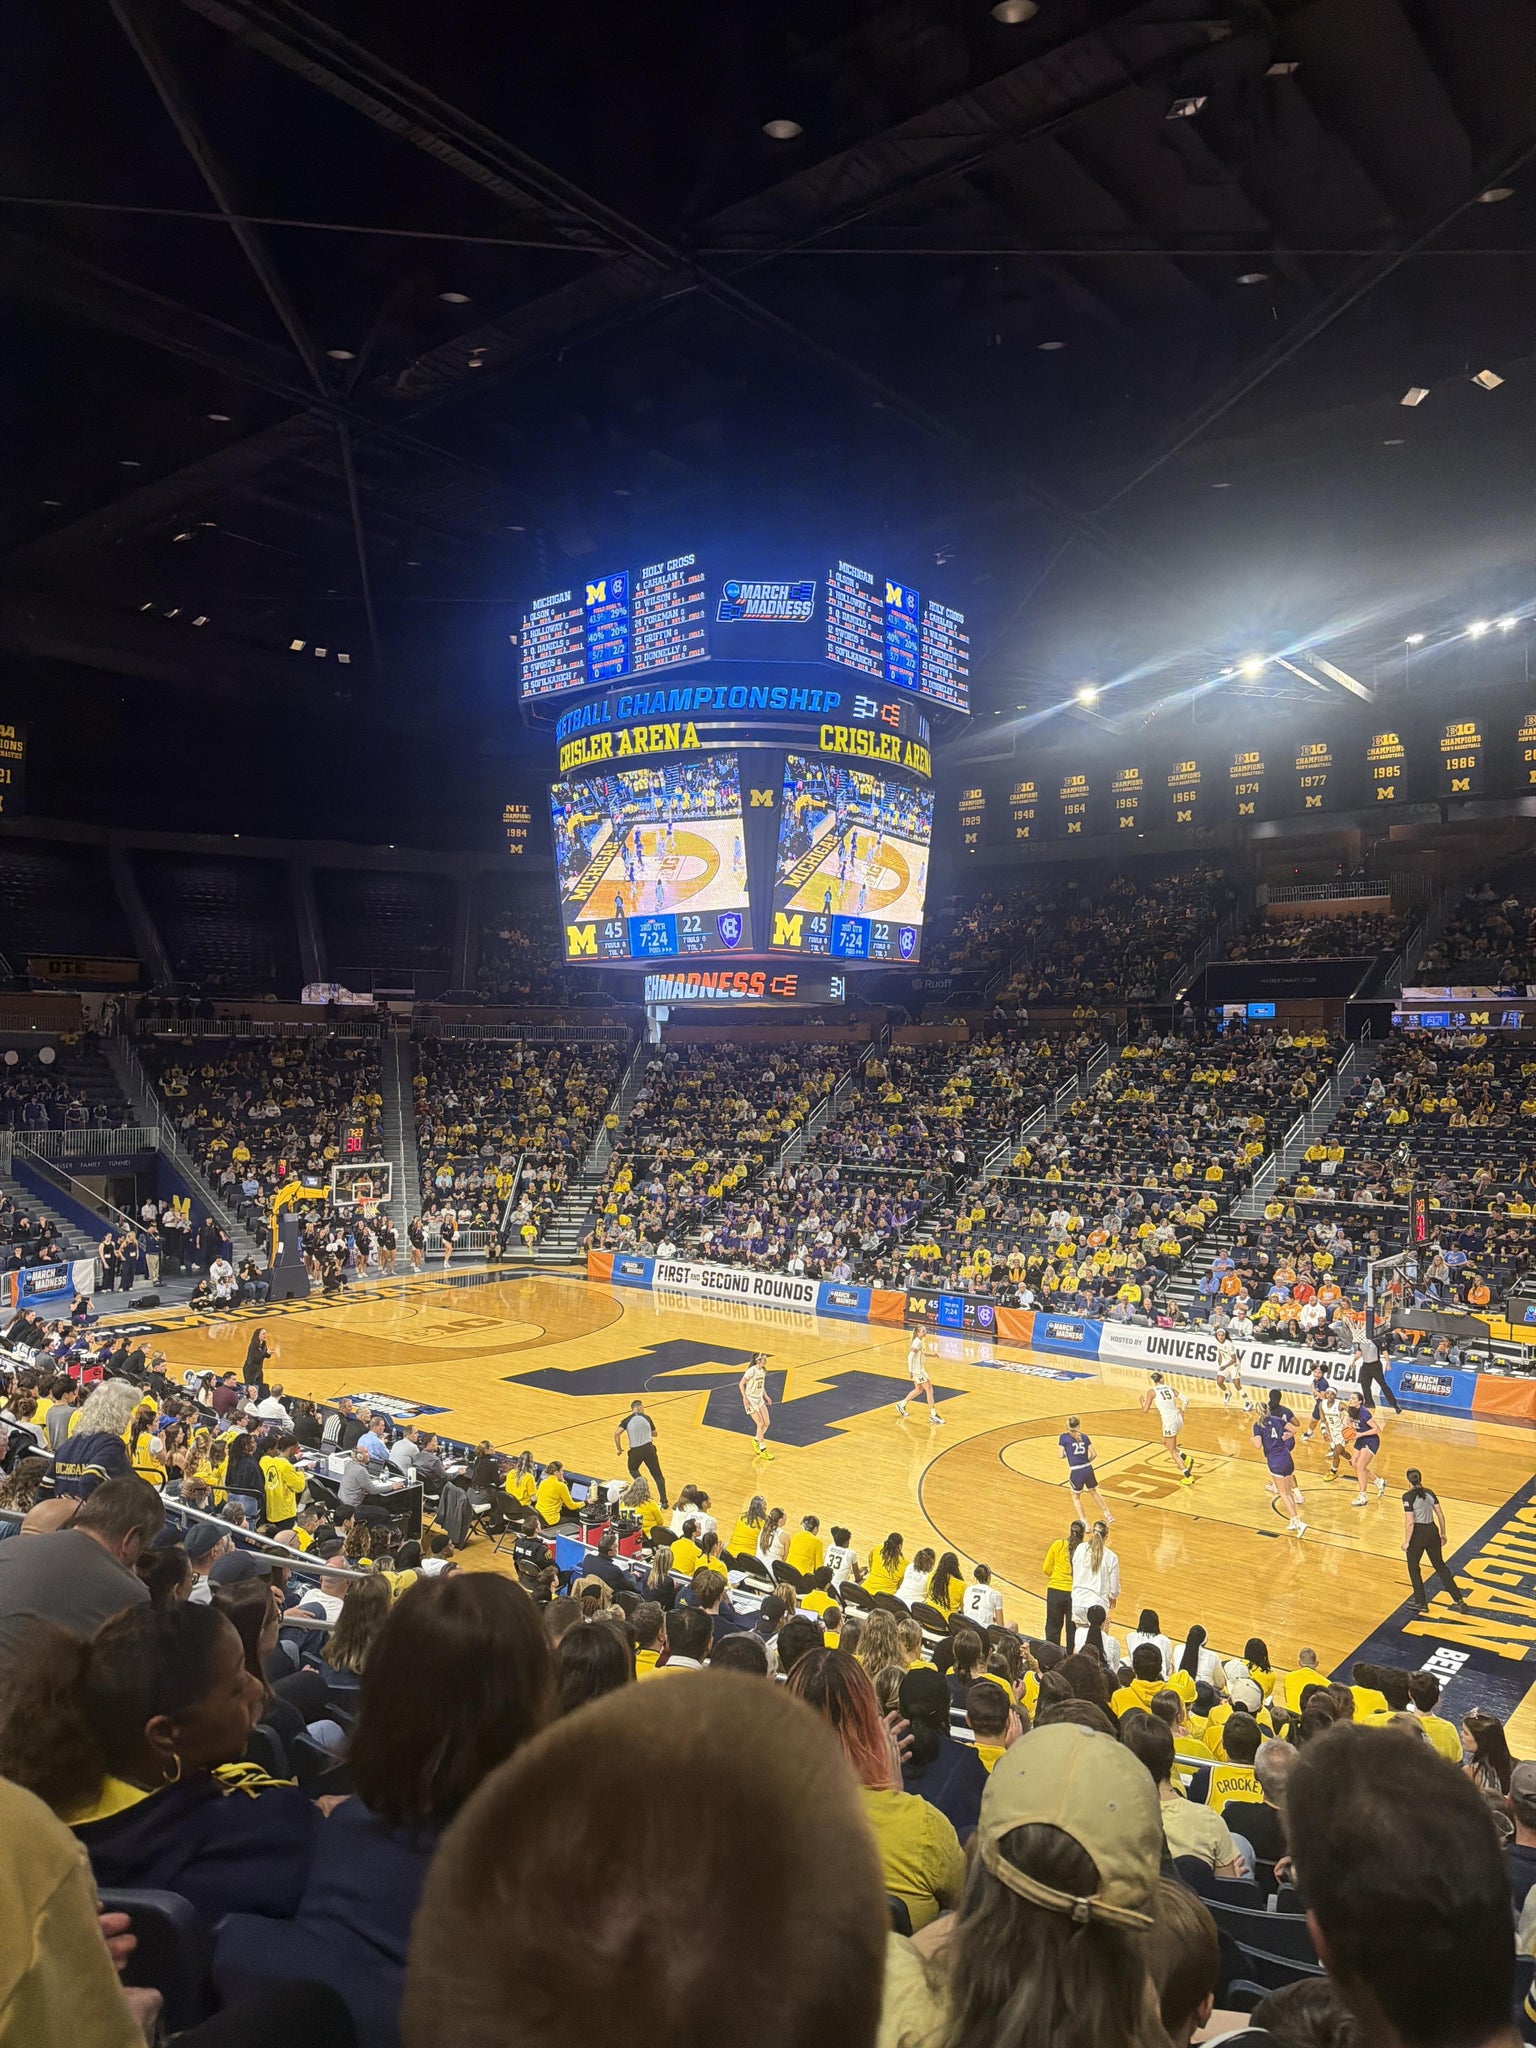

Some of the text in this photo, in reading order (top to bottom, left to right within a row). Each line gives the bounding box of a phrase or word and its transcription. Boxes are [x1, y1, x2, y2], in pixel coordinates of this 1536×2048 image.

[642, 554, 695, 579] HOLY CROSS
[839, 560, 874, 585] MICHIGAN
[836, 572, 854, 589] OLSON
[585, 581, 606, 605] M
[740, 584, 789, 599] MARCH
[885, 583, 902, 607] M
[533, 590, 571, 610] MICHIGAN
[644, 592, 671, 607] WILSON
[610, 606, 628, 619] 29%
[746, 600, 811, 615] MADNESS
[530, 609, 550, 621] OLSON
[644, 608, 679, 625] FOREMAN
[946, 608, 965, 624] CROSS
[530, 623, 563, 639] HOLLOWAY
[588, 631, 604, 642] 40%
[611, 625, 627, 638] 20%
[644, 628, 672, 644] GRIFFIN
[835, 628, 859, 643] SWORDS
[887, 632, 900, 644] 40%
[537, 639, 564, 654] DANIELS
[613, 644, 625, 655] 2/2
[644, 645, 681, 661] DONNELLY
[531, 658, 556, 672] SWORDS
[617, 686, 841, 719] CHAMPIONSHIP
[820, 724, 901, 763] CRISLER
[1440, 735, 1482, 746] CHAMPIONS
[560, 722, 701, 773] CRISLER ARENA
[1366, 745, 1405, 756] CHAMPIONS
[1295, 755, 1332, 765] CHAMPIONS
[1446, 756, 1475, 770] 1986
[1230, 763, 1265, 773] CHAMPIONS
[1373, 765, 1401, 779] 1985
[1167, 771, 1201, 782] CHAMPIONS
[1300, 775, 1327, 788] 1977
[1060, 785, 1089, 795] CHAMPIONS
[1112, 779, 1143, 789] CHAMPIONS
[1235, 783, 1260, 795] 1974
[1451, 778, 1470, 792] M
[749, 789, 774, 807] M
[1009, 792, 1038, 801] CHAMPIONS
[1173, 791, 1196, 803] 1966
[1377, 786, 1395, 800] M
[1116, 797, 1138, 809] 1965
[1305, 795, 1322, 808] M
[1014, 809, 1034, 820] 1948
[1064, 803, 1086, 815] 1964
[1239, 802, 1255, 815] M
[962, 815, 981, 826] 1929
[1120, 816, 1134, 828] M
[1176, 810, 1192, 822] M
[507, 829, 527, 837] 1984
[1016, 827, 1030, 838] M
[1068, 822, 1081, 833] M
[965, 833, 977, 843] M
[510, 844, 523, 854] M
[604, 916, 702, 938] 45 22
[653, 923, 666, 931] QTR
[773, 912, 888, 946] M 45 22
[566, 924, 598, 956] M
[640, 932, 669, 948] 7:24
[839, 933, 863, 948] 7:24
[659, 972, 766, 999] MADNESS
[924, 978, 952, 988] Ruoff
[1470, 1012, 1489, 1024] M
[349, 1128, 364, 1137] 7:23
[346, 1137, 362, 1152] 30
[32, 1268, 56, 1281] MARCH
[35, 1275, 67, 1290] MADNESS
[657, 1263, 691, 1284] FIRST
[701, 1270, 751, 1293] SECOND
[754, 1278, 814, 1303] ROUNDS
[153, 1280, 449, 1331] MICHIGAN
[909, 1297, 926, 1314] M
[928, 1299, 938, 1309] 45
[964, 1304, 975, 1315] 22
[944, 1307, 958, 1316] 7:24
[1053, 1322, 1074, 1332] MARCH
[1055, 1331, 1083, 1342] MADNESS
[1110, 1335, 1135, 1345] HOSTED
[1136, 1338, 1143, 1346] BY
[1146, 1336, 1246, 1362] UNIVERSY
[1250, 1351, 1273, 1371] OF
[1411, 1374, 1439, 1384] MARCH
[1414, 1382, 1450, 1394] MADNESS
[1160, 1390, 1172, 1400] 15
[1271, 1427, 1278, 1439] 4
[1072, 1442, 1085, 1455] 25
[827, 1554, 843, 1570] 33
[972, 1595, 981, 1610] 2
[1216, 1777, 1263, 1795] CROCKE
